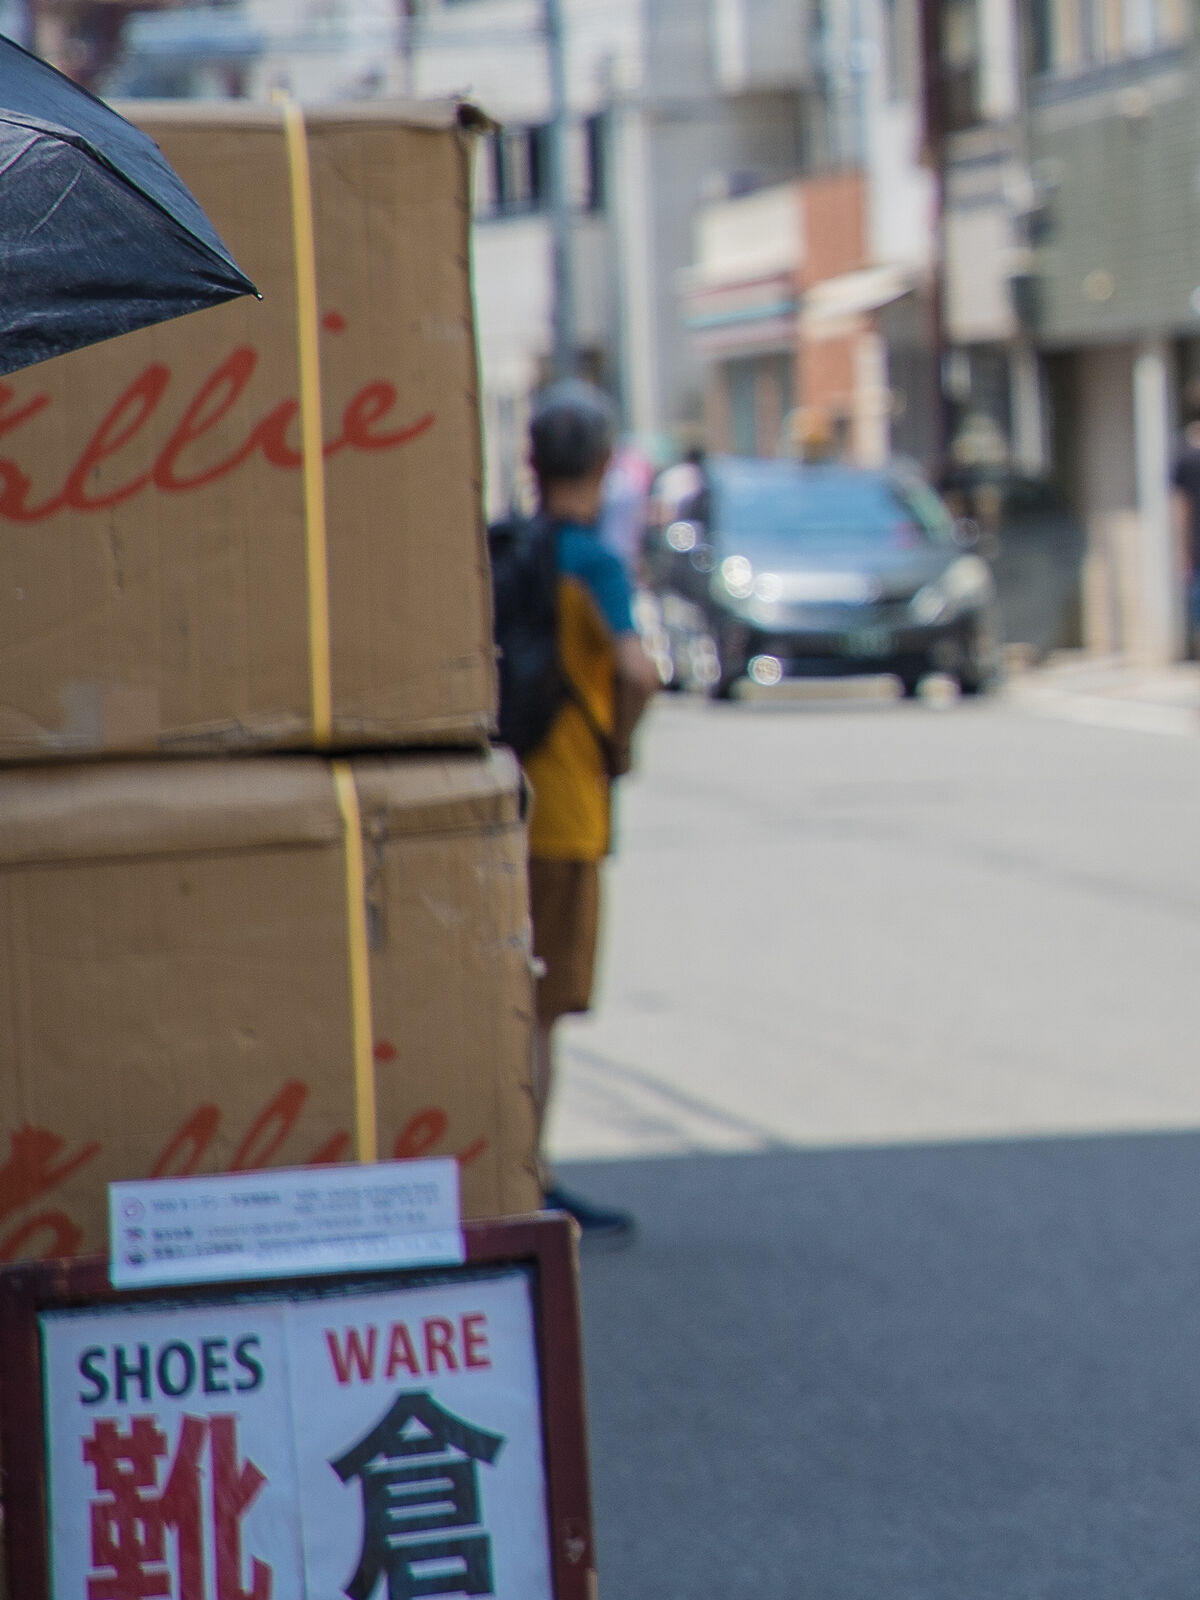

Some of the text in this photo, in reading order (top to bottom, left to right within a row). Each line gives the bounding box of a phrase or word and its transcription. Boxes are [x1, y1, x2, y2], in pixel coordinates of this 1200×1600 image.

[78, 1331, 265, 1406] SHOES
[325, 1311, 493, 1386] WARE
[81, 1411, 274, 1600] 靴
[328, 1389, 508, 1600] 倉
